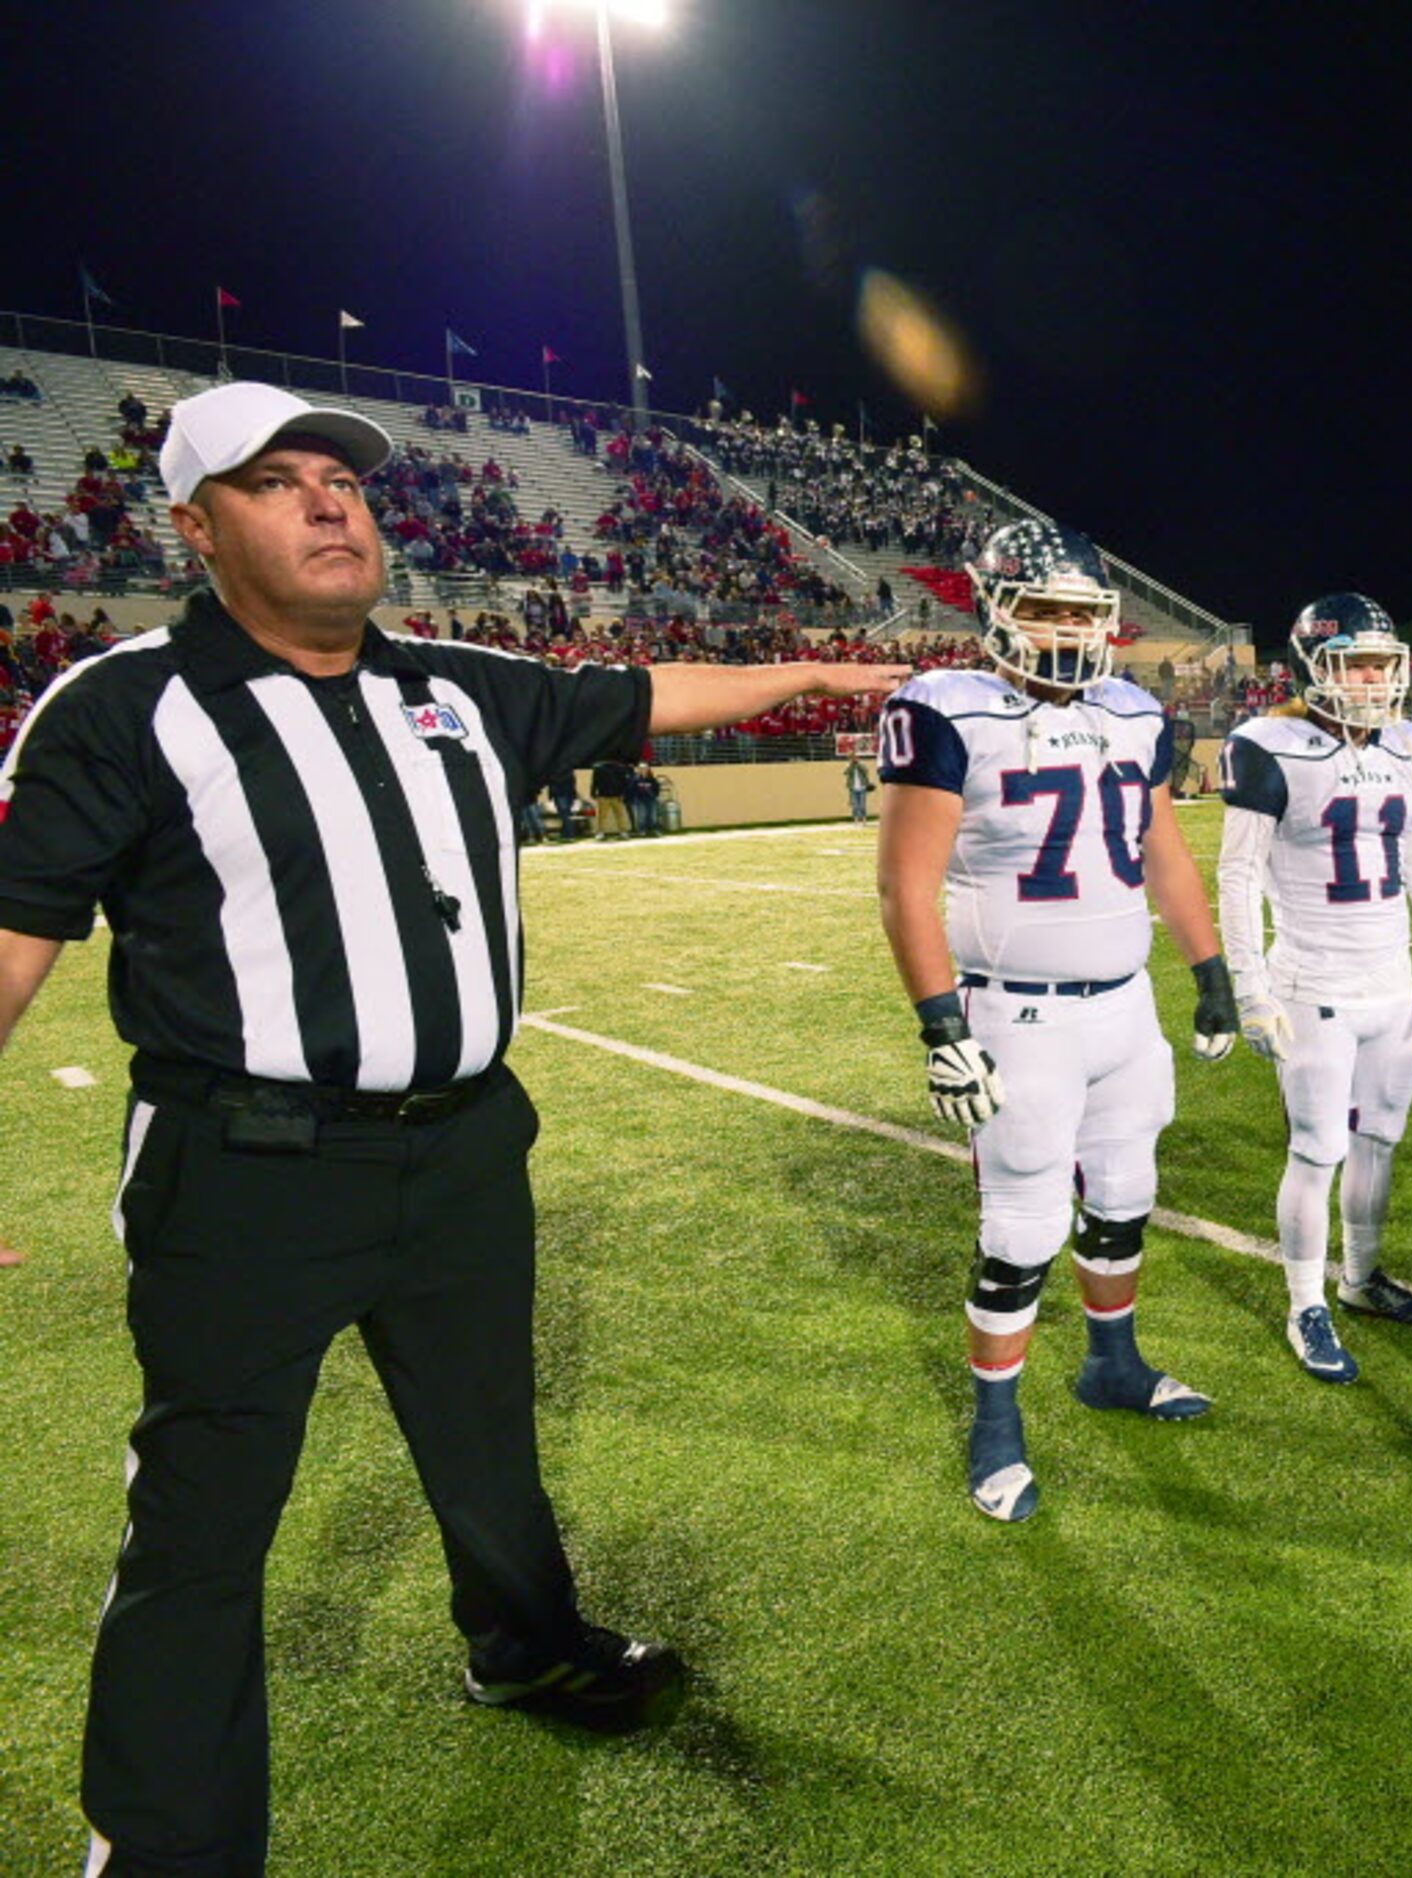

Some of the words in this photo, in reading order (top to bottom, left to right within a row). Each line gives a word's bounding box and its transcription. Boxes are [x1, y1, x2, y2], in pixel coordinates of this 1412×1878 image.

[879, 708, 915, 768] 0
[1000, 762, 1153, 902] 70
[1321, 794, 1406, 904] 11
